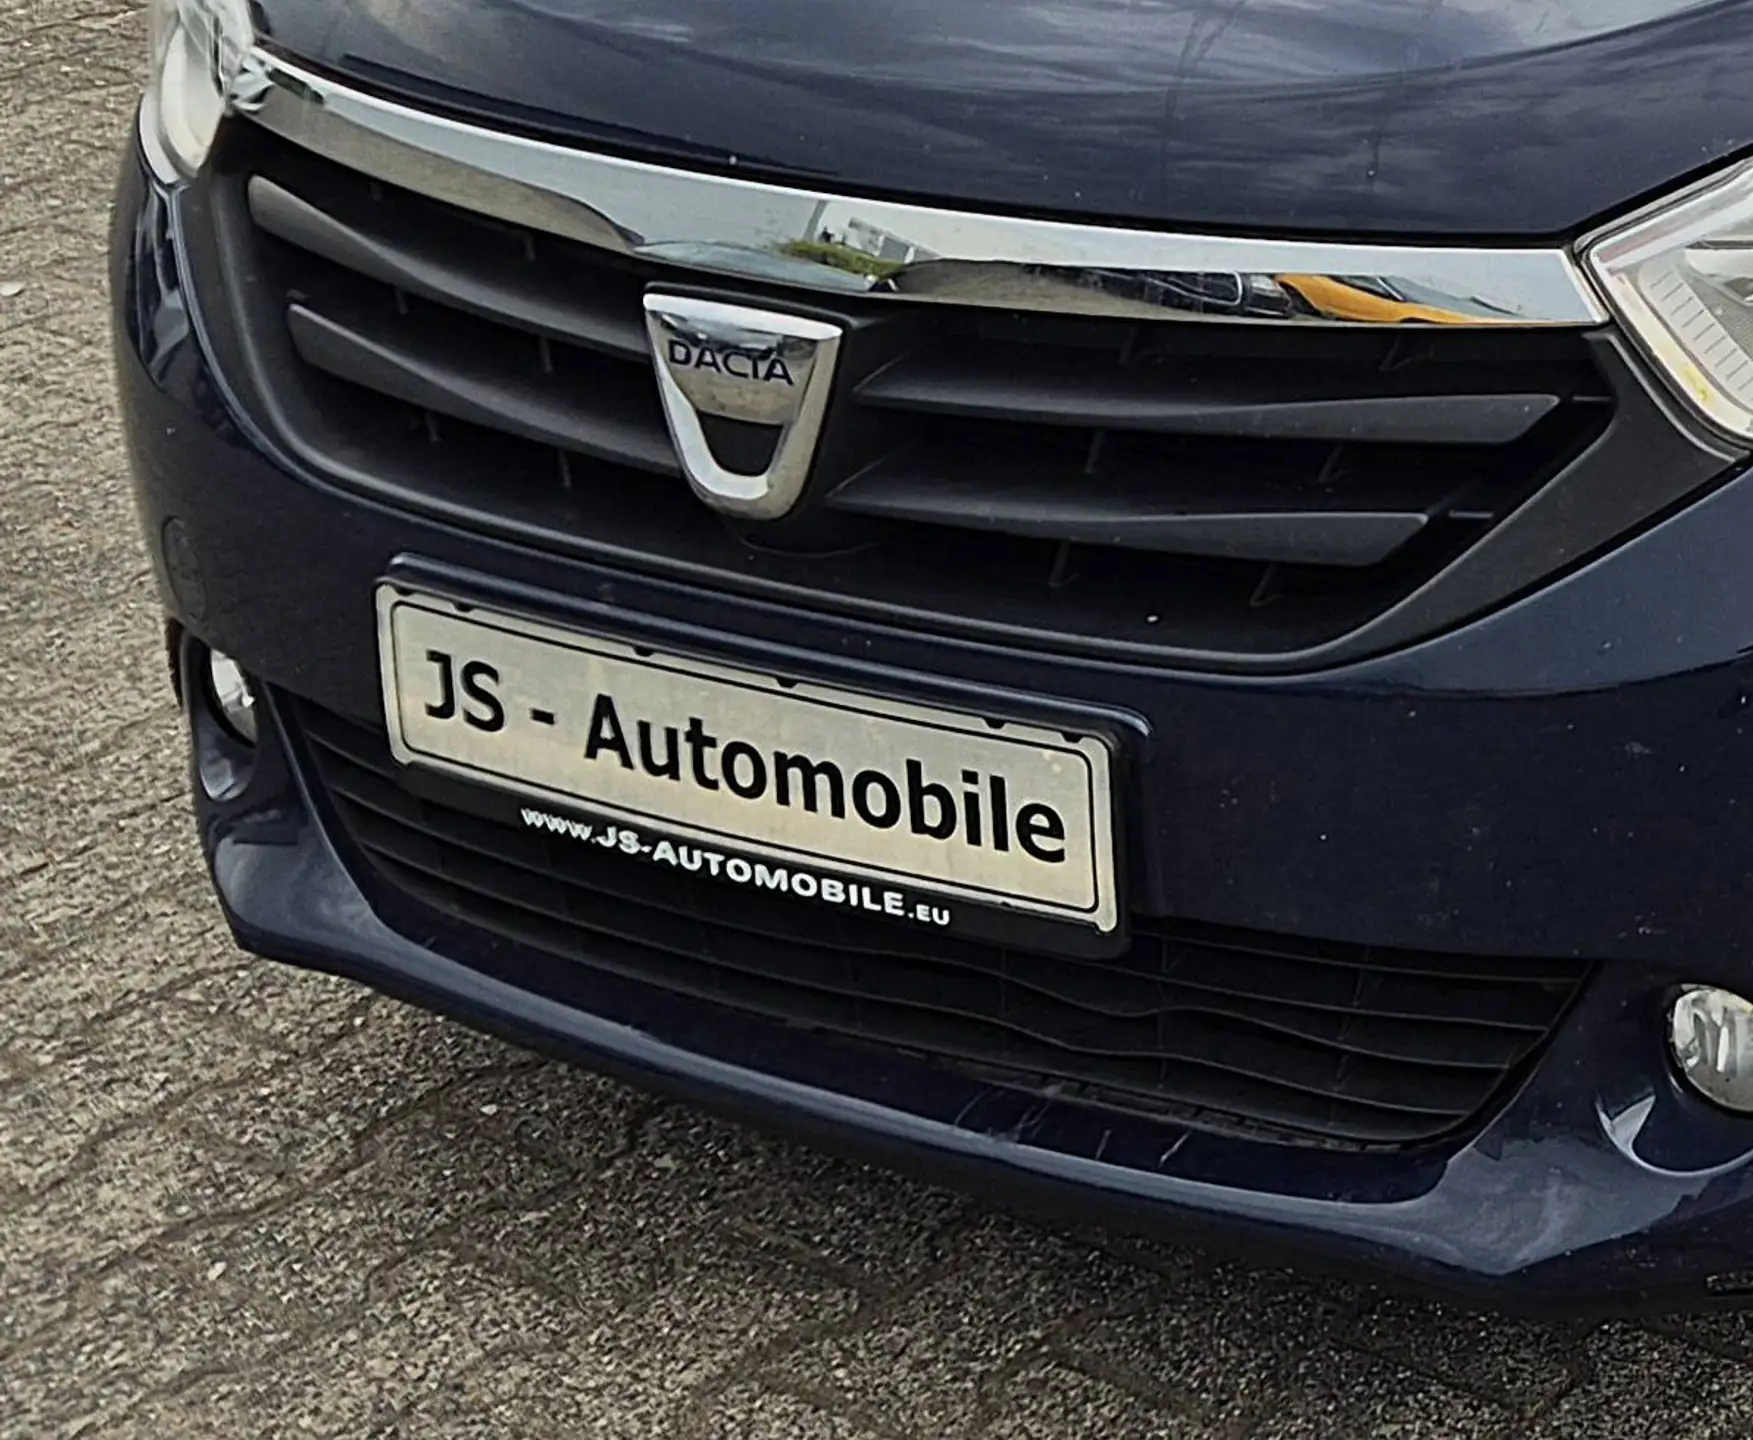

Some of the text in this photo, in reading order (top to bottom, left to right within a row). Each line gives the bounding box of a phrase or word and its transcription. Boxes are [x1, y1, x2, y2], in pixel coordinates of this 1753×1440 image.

[667, 338, 795, 387] DACIA
[424, 649, 507, 733] JS
[583, 692, 1068, 864] Automobile
